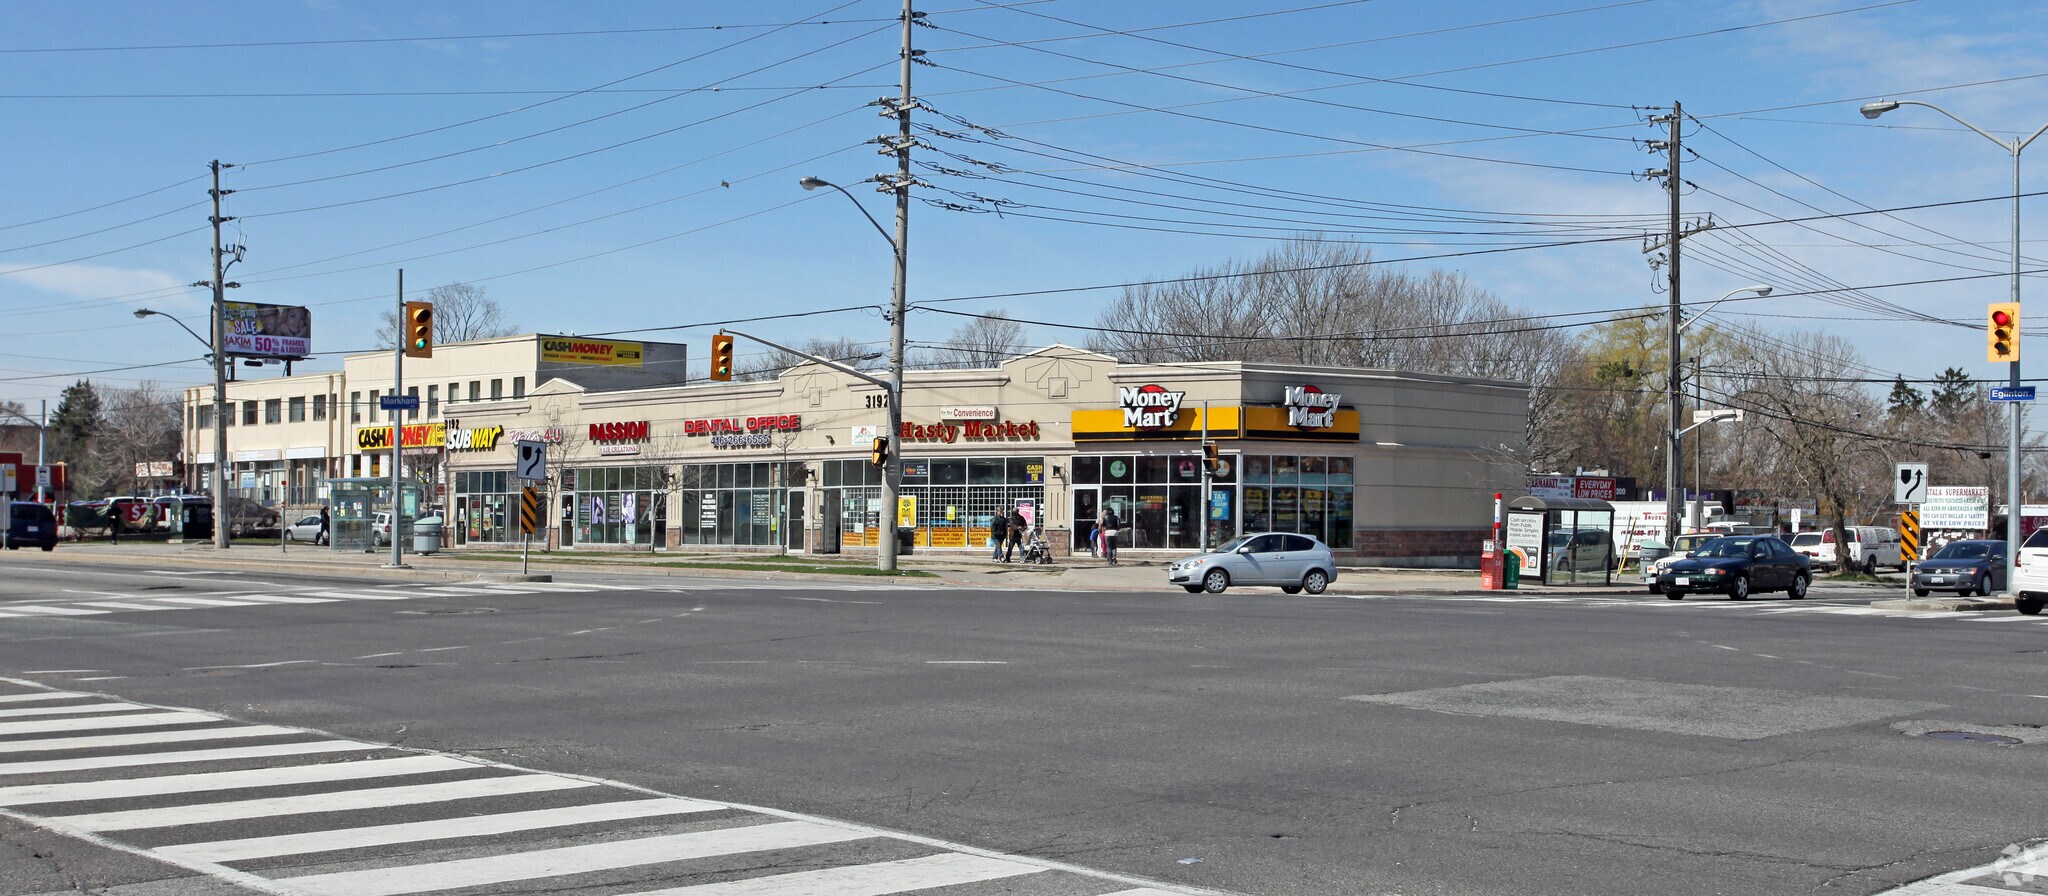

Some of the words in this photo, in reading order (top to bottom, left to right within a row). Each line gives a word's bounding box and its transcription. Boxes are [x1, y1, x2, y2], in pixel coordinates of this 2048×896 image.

[234, 319, 257, 335] SALE
[383, 396, 418, 405] Markham
[866, 394, 888, 408] 3192
[1119, 387, 1184, 413] Money
[1284, 385, 1342, 414] Money
[1992, 389, 2029, 399] Eglinton
[953, 408, 994, 417] Convenience
[1123, 407, 1174, 427] Mart
[1288, 406, 1334, 428] Mart
[589, 421, 648, 440] PASSION
[684, 418, 741, 433] DENTAL
[746, 414, 799, 431] OFFICE
[900, 421, 958, 443] Hasty
[963, 418, 1039, 438] Market
[447, 425, 501, 450] SUBWAY
[711, 433, 771, 447] 416-266-6555
[599, 446, 611, 454] HAIR
[611, 445, 637, 454] CREATIONS
[1579, 480, 1612, 489] EVERYDAY
[1577, 490, 1589, 498] LOW
[1590, 490, 1613, 498] PRICES
